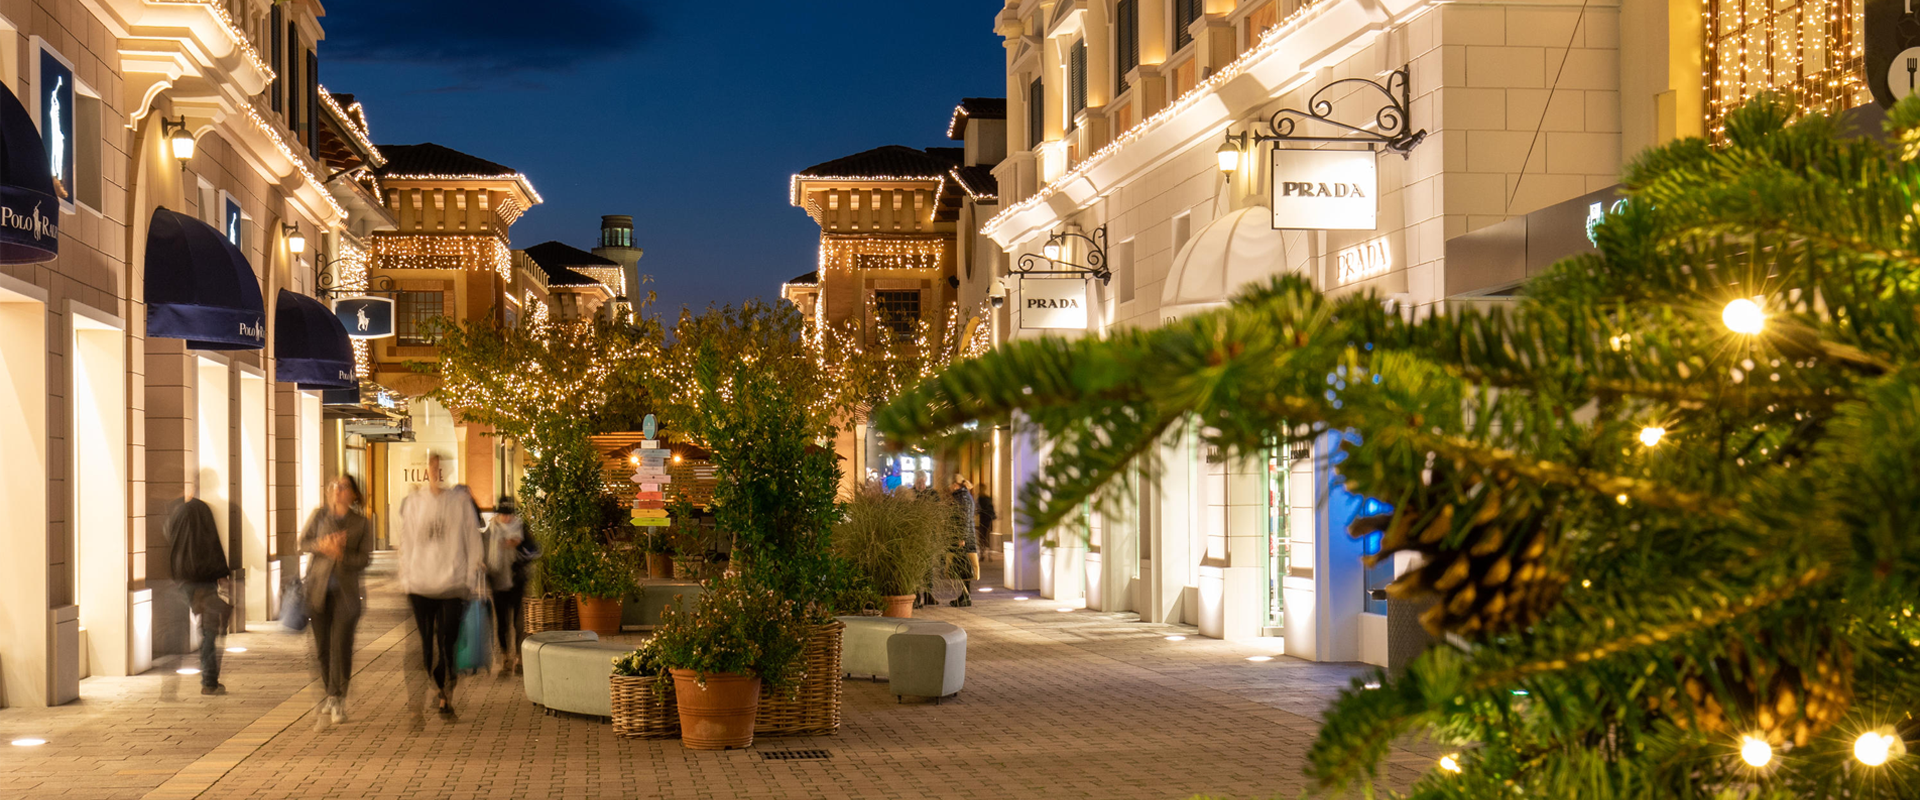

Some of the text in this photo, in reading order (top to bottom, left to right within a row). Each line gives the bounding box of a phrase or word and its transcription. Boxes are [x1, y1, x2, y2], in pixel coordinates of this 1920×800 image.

[1282, 181, 1366, 198] PRADA
[1336, 241, 1387, 280] PRADA
[1027, 298, 1079, 309] PRADA
